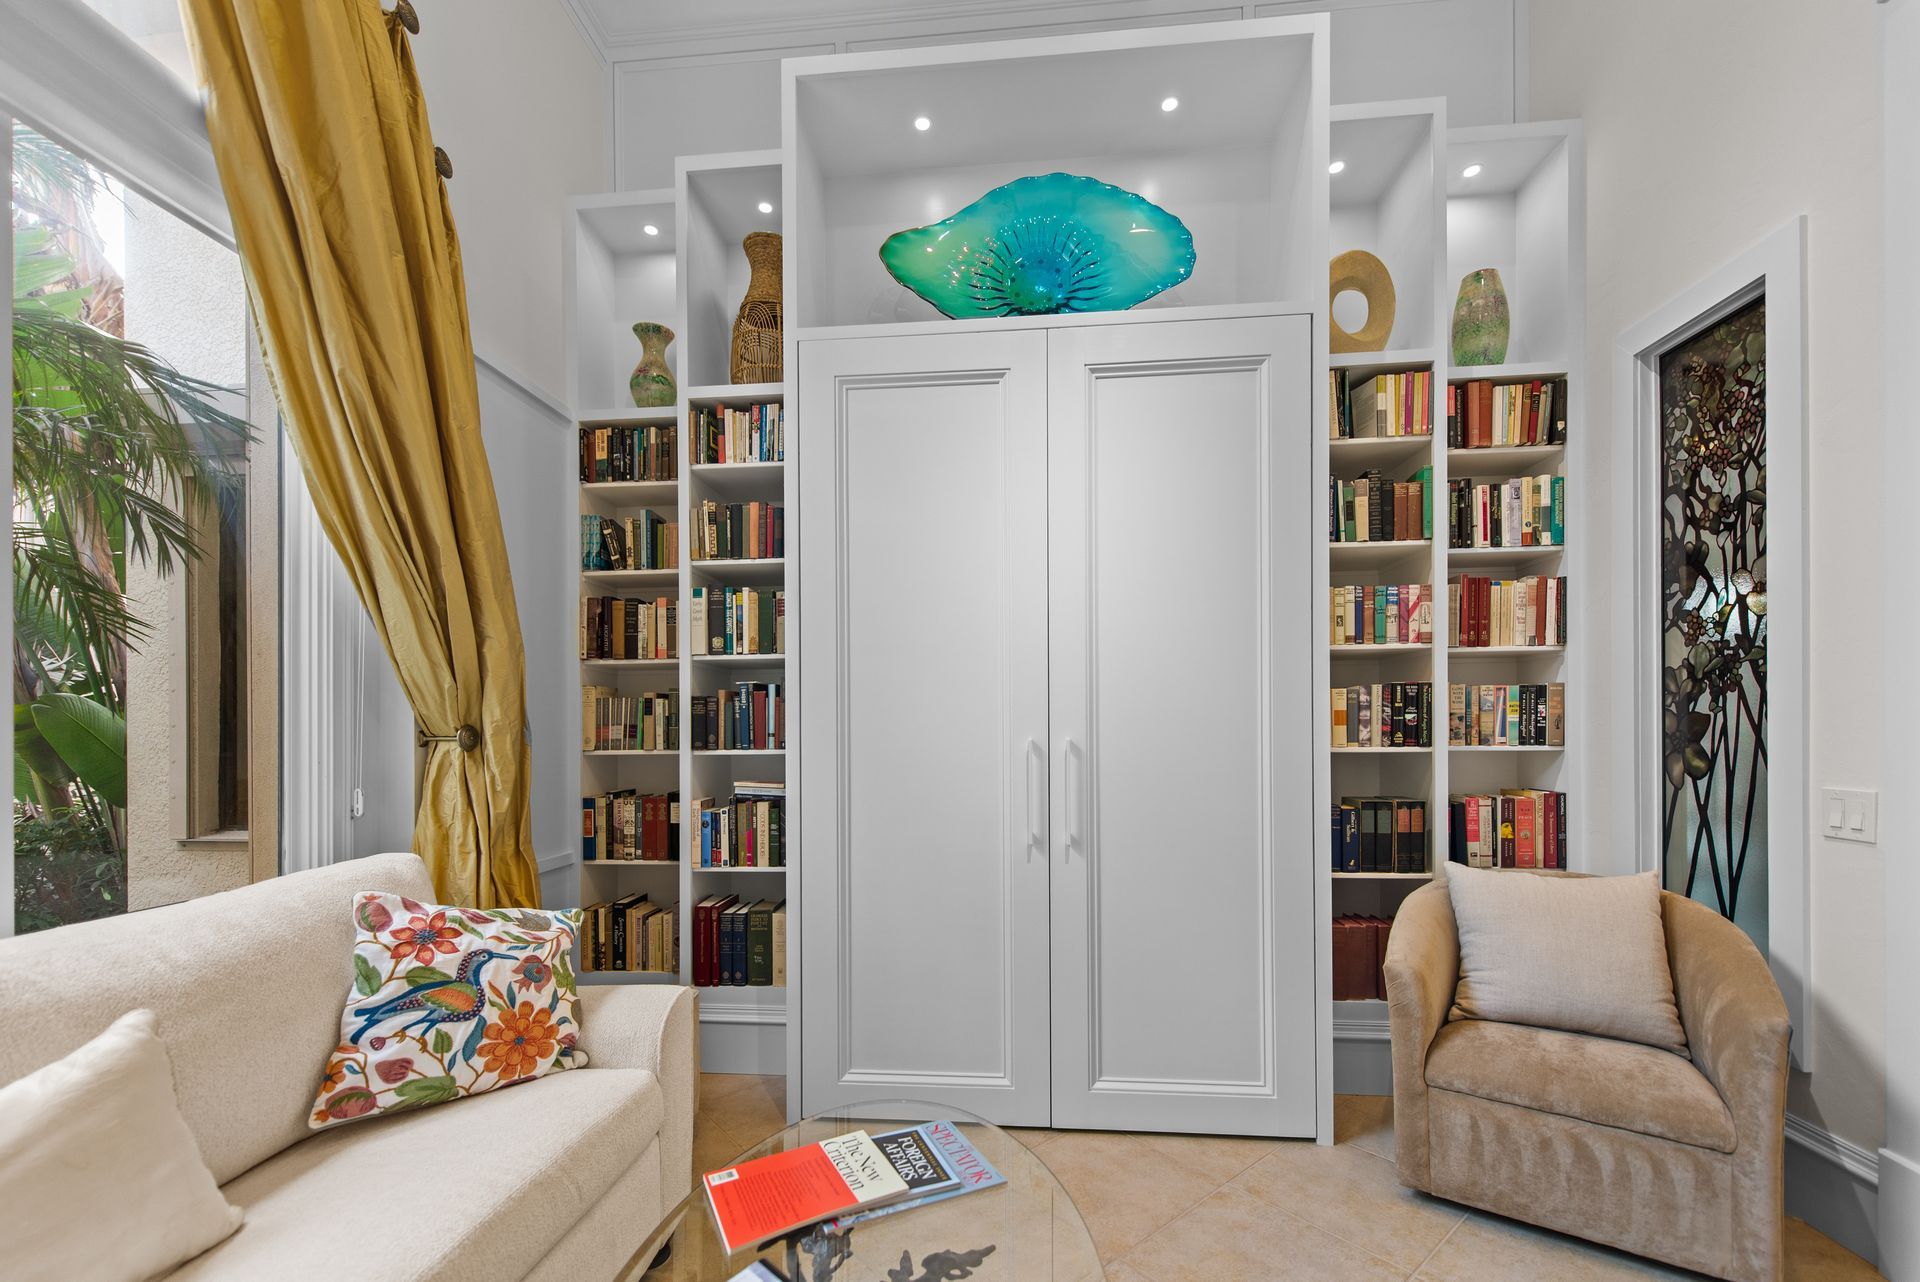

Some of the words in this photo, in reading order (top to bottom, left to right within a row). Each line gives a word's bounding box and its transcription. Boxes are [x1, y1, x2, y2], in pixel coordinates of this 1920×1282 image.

[824, 1141, 864, 1190] Criterion
[842, 1135, 863, 1157] The
[855, 1155, 883, 1181] New
[883, 1143, 918, 1180] AFFAIRS
[898, 1136, 937, 1179] FOREIGN
[926, 1124, 993, 1184] SPECTATOR
